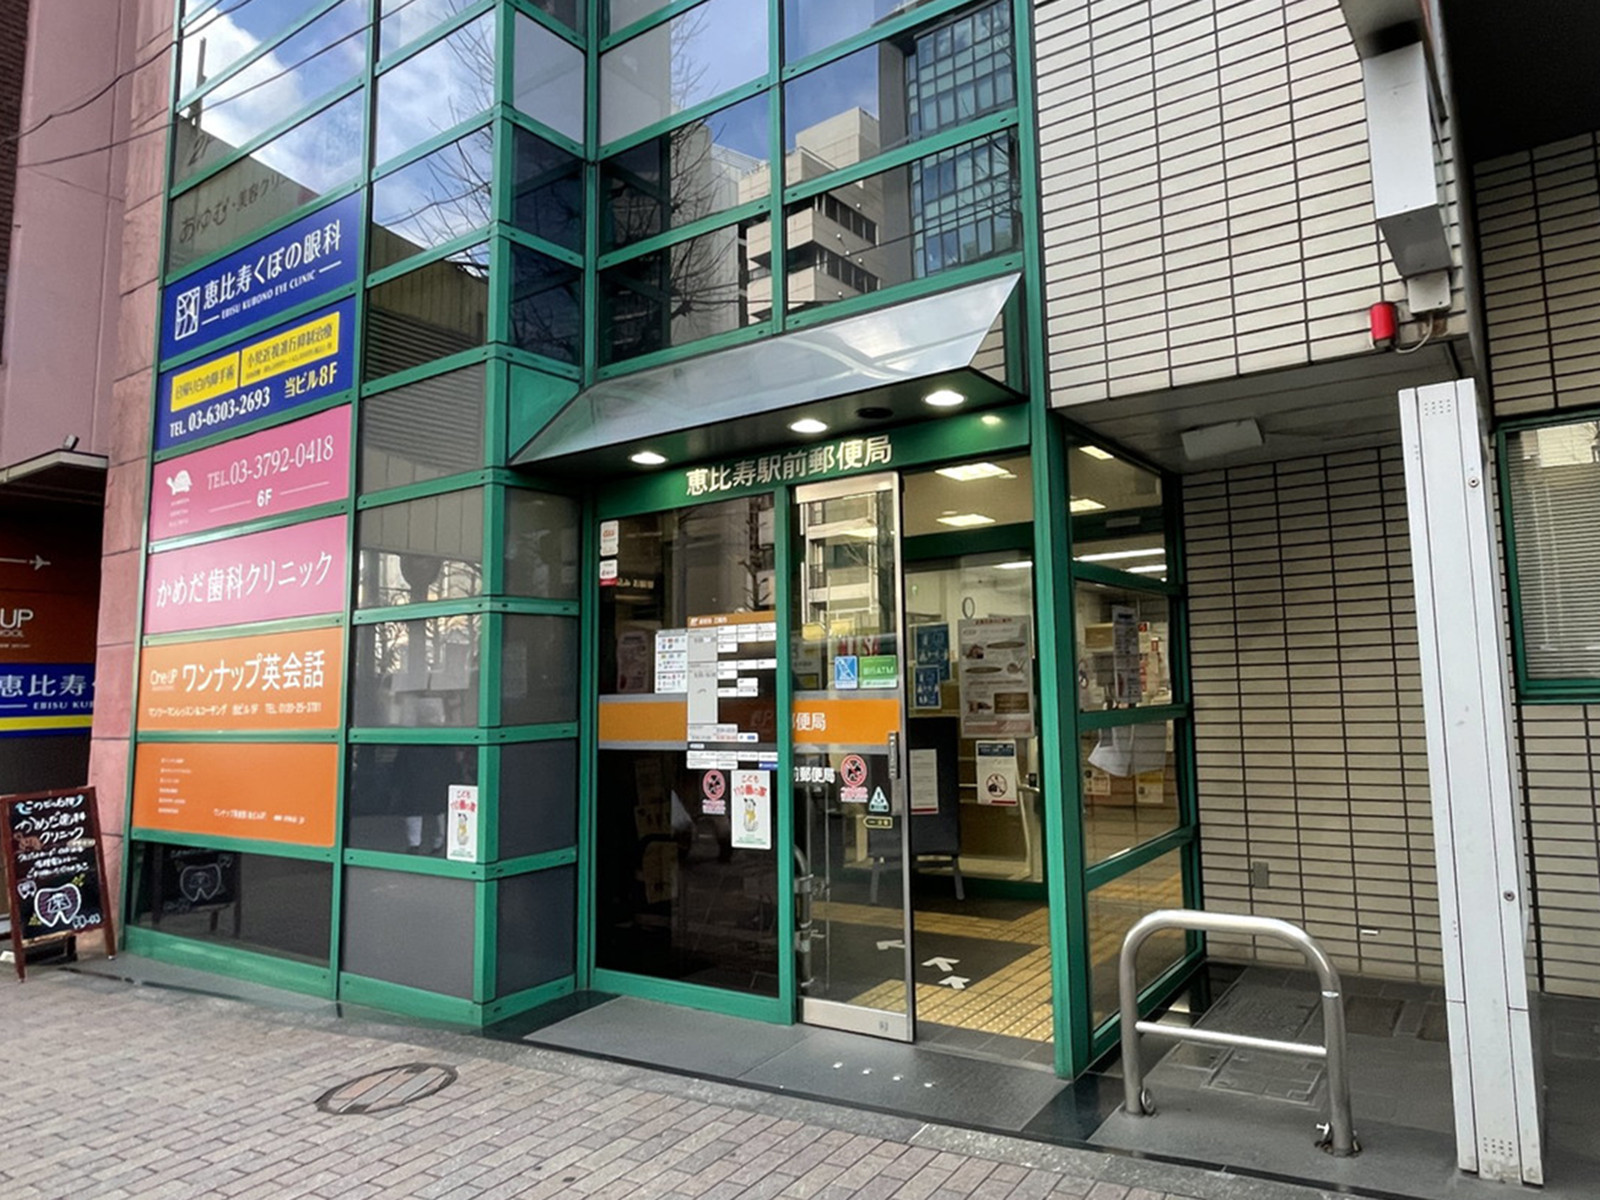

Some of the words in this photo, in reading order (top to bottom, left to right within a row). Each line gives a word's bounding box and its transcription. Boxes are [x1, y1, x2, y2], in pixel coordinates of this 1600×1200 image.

[203, 219, 341, 310] 恵比寿くぼの眼科
[221, 303, 241, 319] EBISU
[242, 289, 274, 310] KUBONO
[275, 281, 288, 296] EYE
[289, 269, 316, 290] CLINIC
[284, 361, 338, 399] 当ビル8F
[170, 423, 187, 437] TEL.
[188, 386, 271, 431] 03-6303-2693
[686, 434, 892, 496] 恵比寿駅前郵便局
[257, 488, 273, 507] 6F
[156, 551, 333, 608] かめだ歯科クリニック
[0, 608, 34, 629] UP
[0, 629, 24, 638] OOL
[0, 674, 95, 698] 恵比寿
[182, 650, 326, 692] ワンナップ英会話
[33, 701, 68, 710] EBISU
[792, 712, 827, 732] 便局
